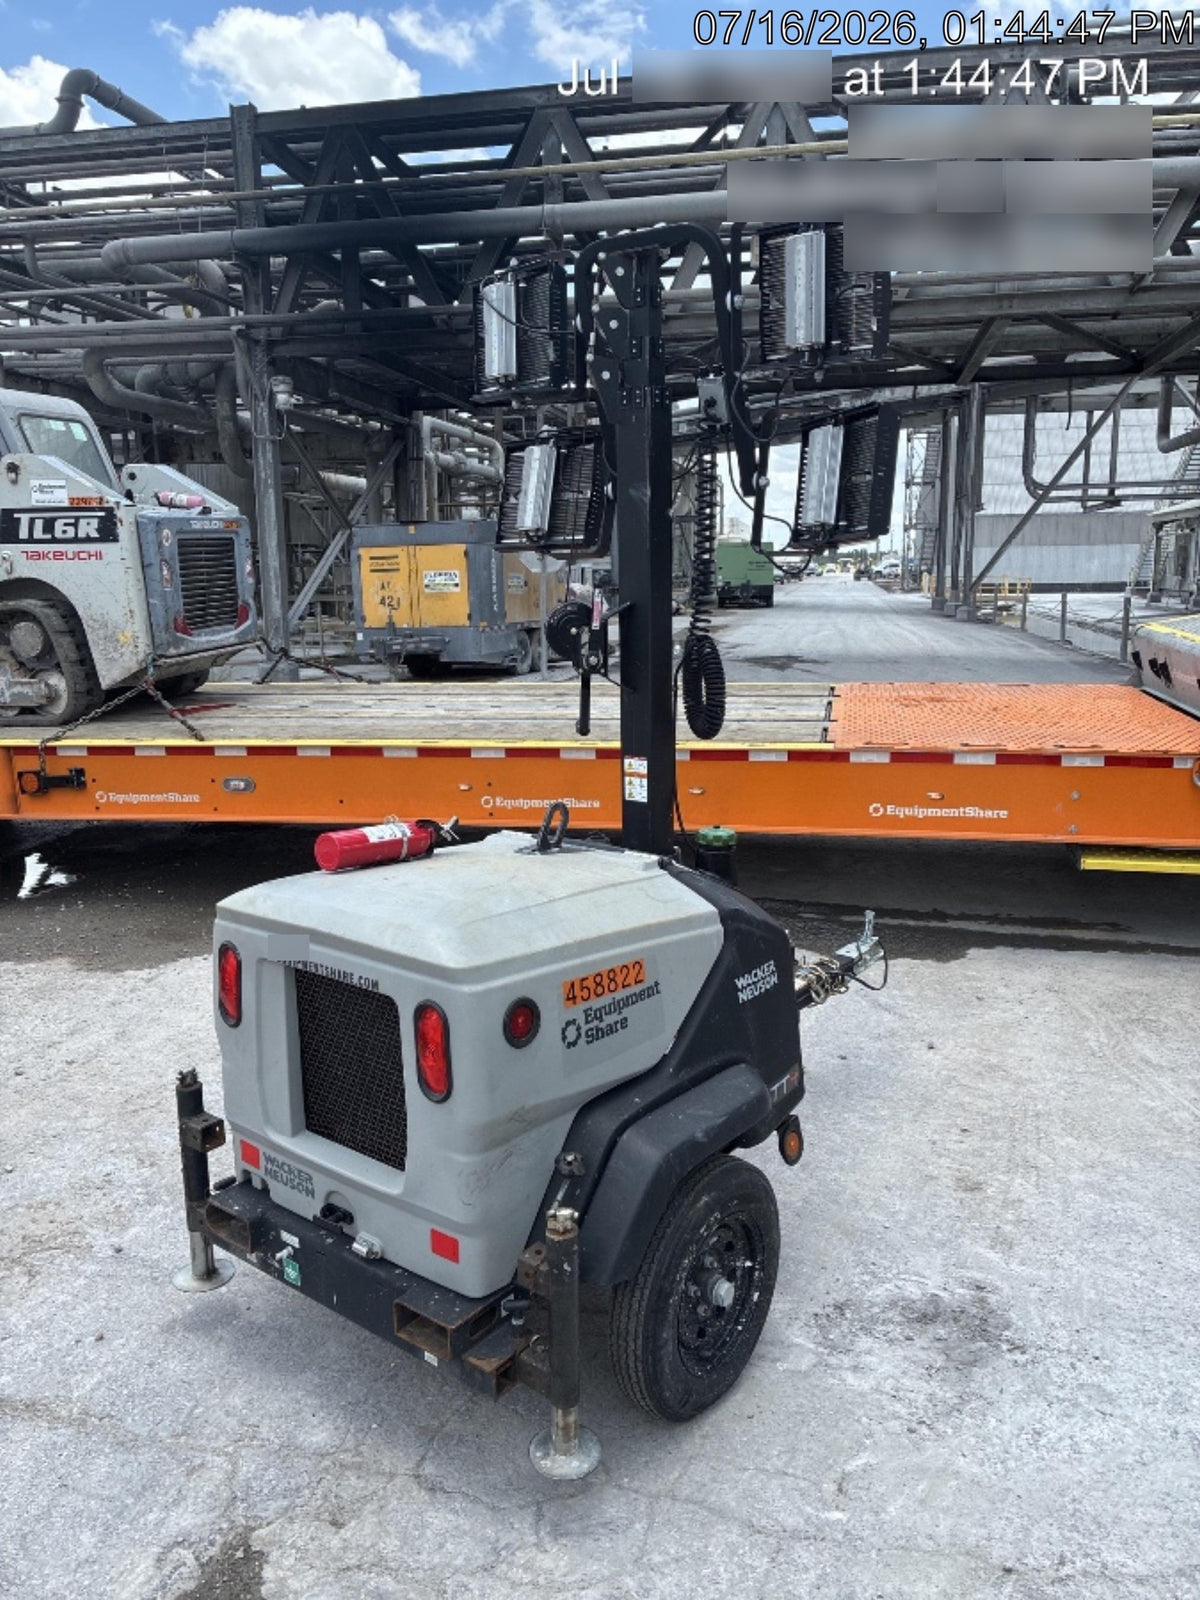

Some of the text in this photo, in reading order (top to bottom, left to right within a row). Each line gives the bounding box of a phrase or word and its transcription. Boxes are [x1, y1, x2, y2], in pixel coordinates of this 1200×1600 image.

[13, 511, 105, 540] TL6R
[107, 792, 201, 804] EquipmentShare
[886, 804, 1009, 819] EquipmentShare
[565, 960, 645, 1005] 458822
[735, 960, 777, 990] WACKER
[737, 973, 779, 1004] NEUSON
[583, 980, 662, 1025] Equipment
[585, 1016, 629, 1046] Share
[263, 1151, 314, 1186] WACKER
[264, 1165, 315, 1200] NEUSON
